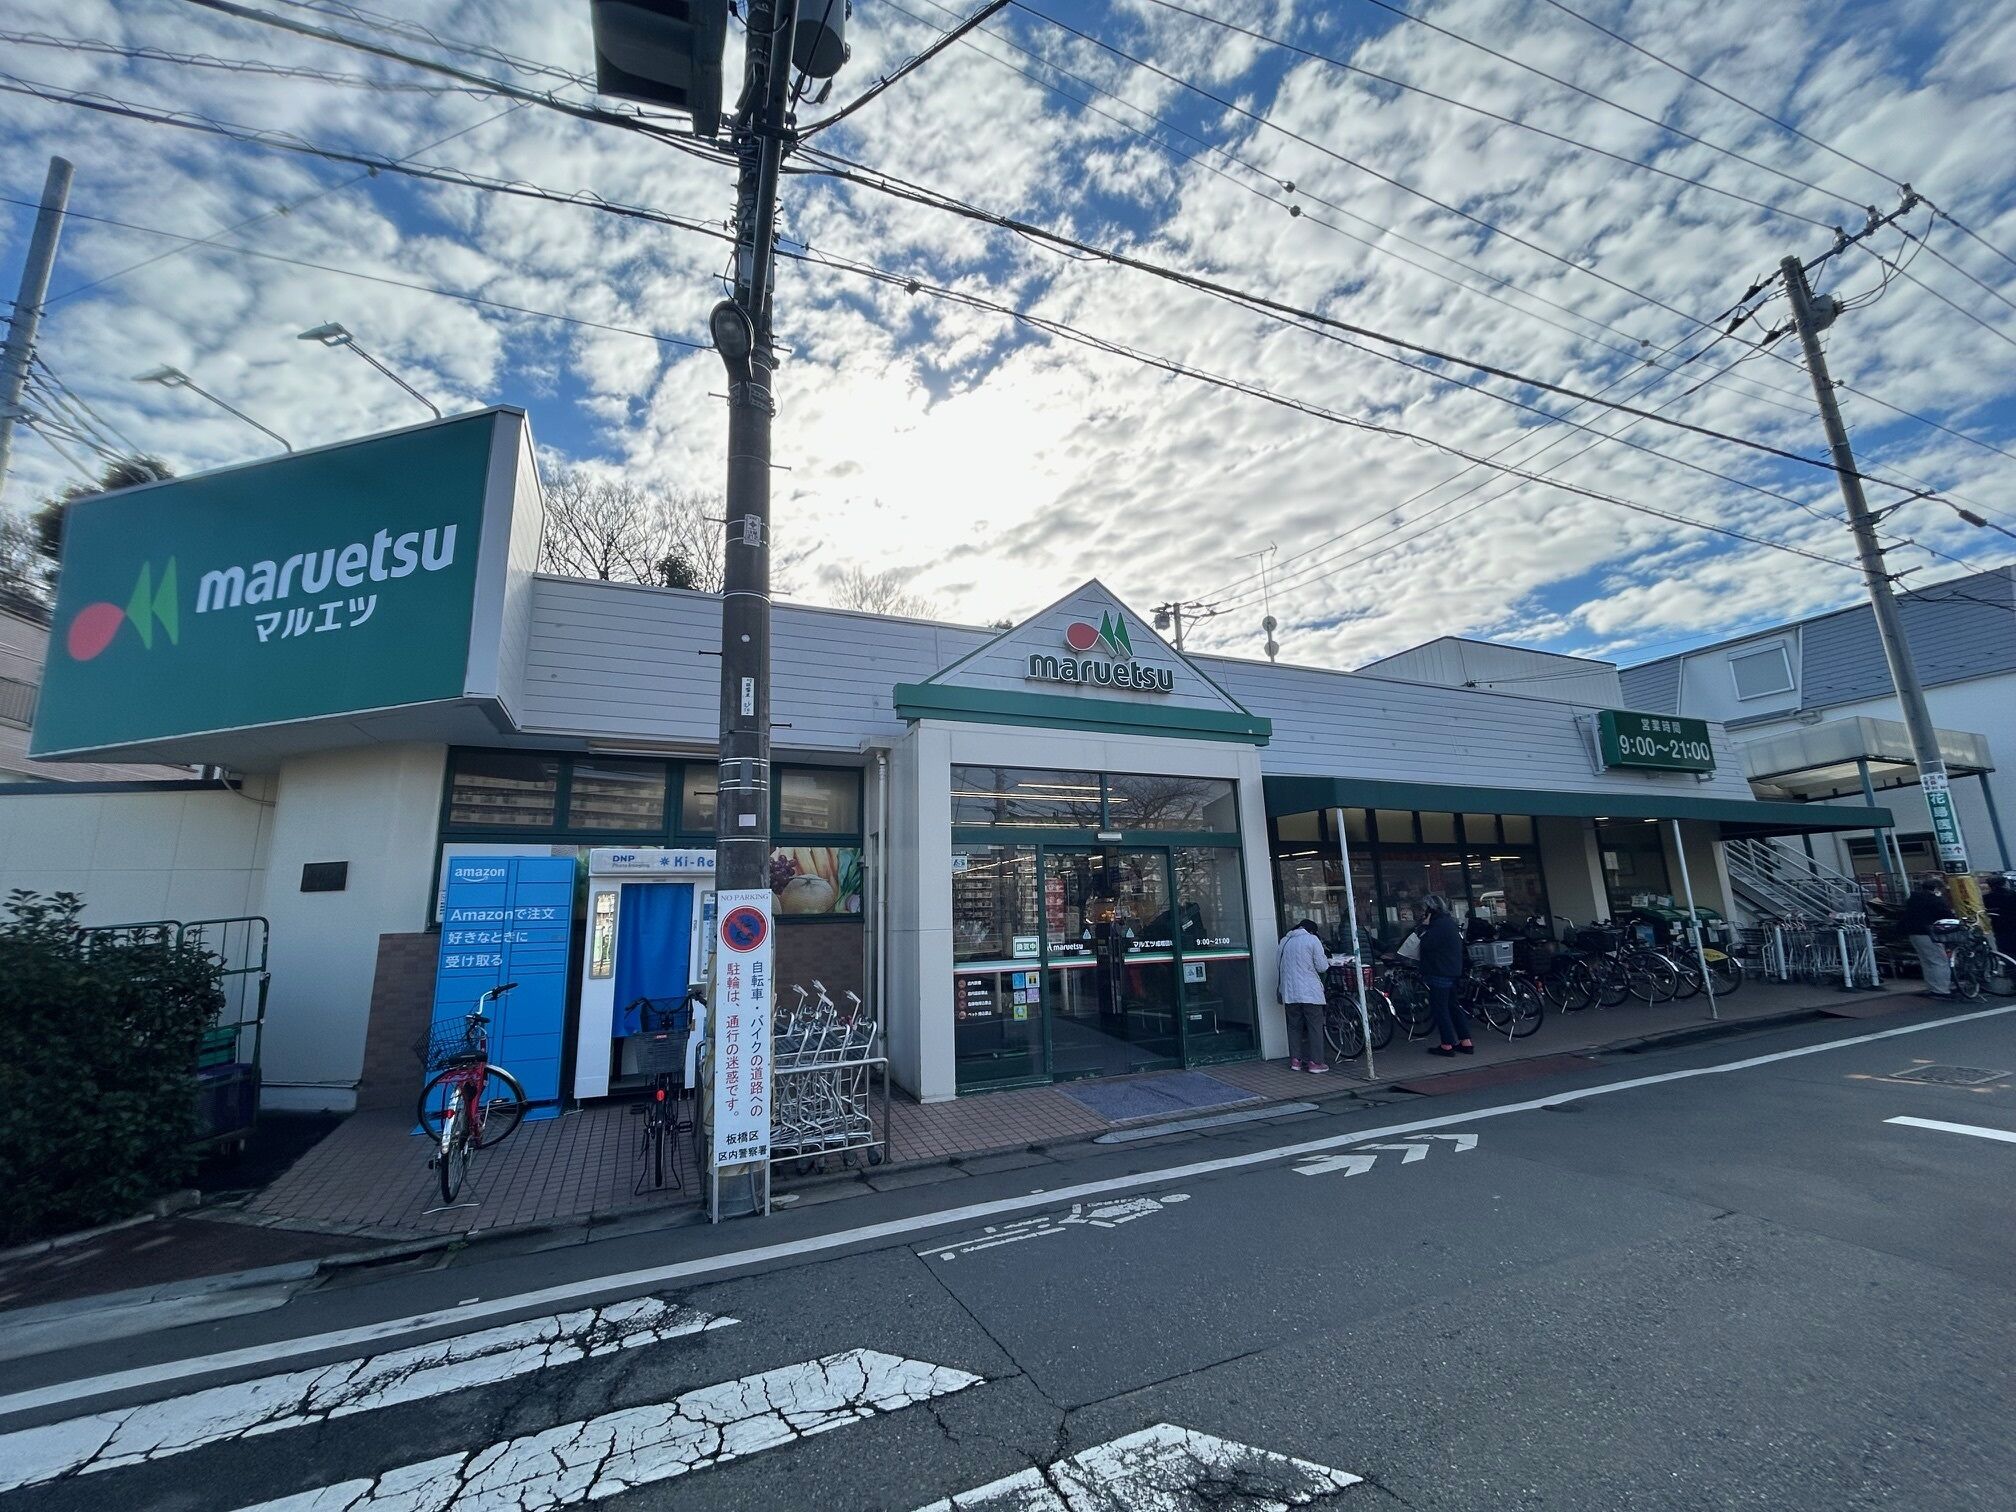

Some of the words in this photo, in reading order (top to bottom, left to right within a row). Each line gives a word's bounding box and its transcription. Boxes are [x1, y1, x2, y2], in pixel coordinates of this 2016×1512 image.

[196, 524, 457, 613] maruetsu
[254, 594, 377, 643] マルエツ
[1029, 654, 1174, 692] maruetsu
[1641, 718, 1682, 734] 営業時間
[612, 855, 635, 863] DNP
[454, 868, 505, 878] amazon
[735, 893, 769, 901] PARKING
[450, 907, 556, 921] Amazonで注文
[447, 931, 529, 945] 好きなときに
[1053, 943, 1084, 951] maruetsu
[445, 954, 503, 969] 受け取る
[726, 1130, 760, 1146] 板橋区
[718, 1144, 768, 1162] 区内警察署
